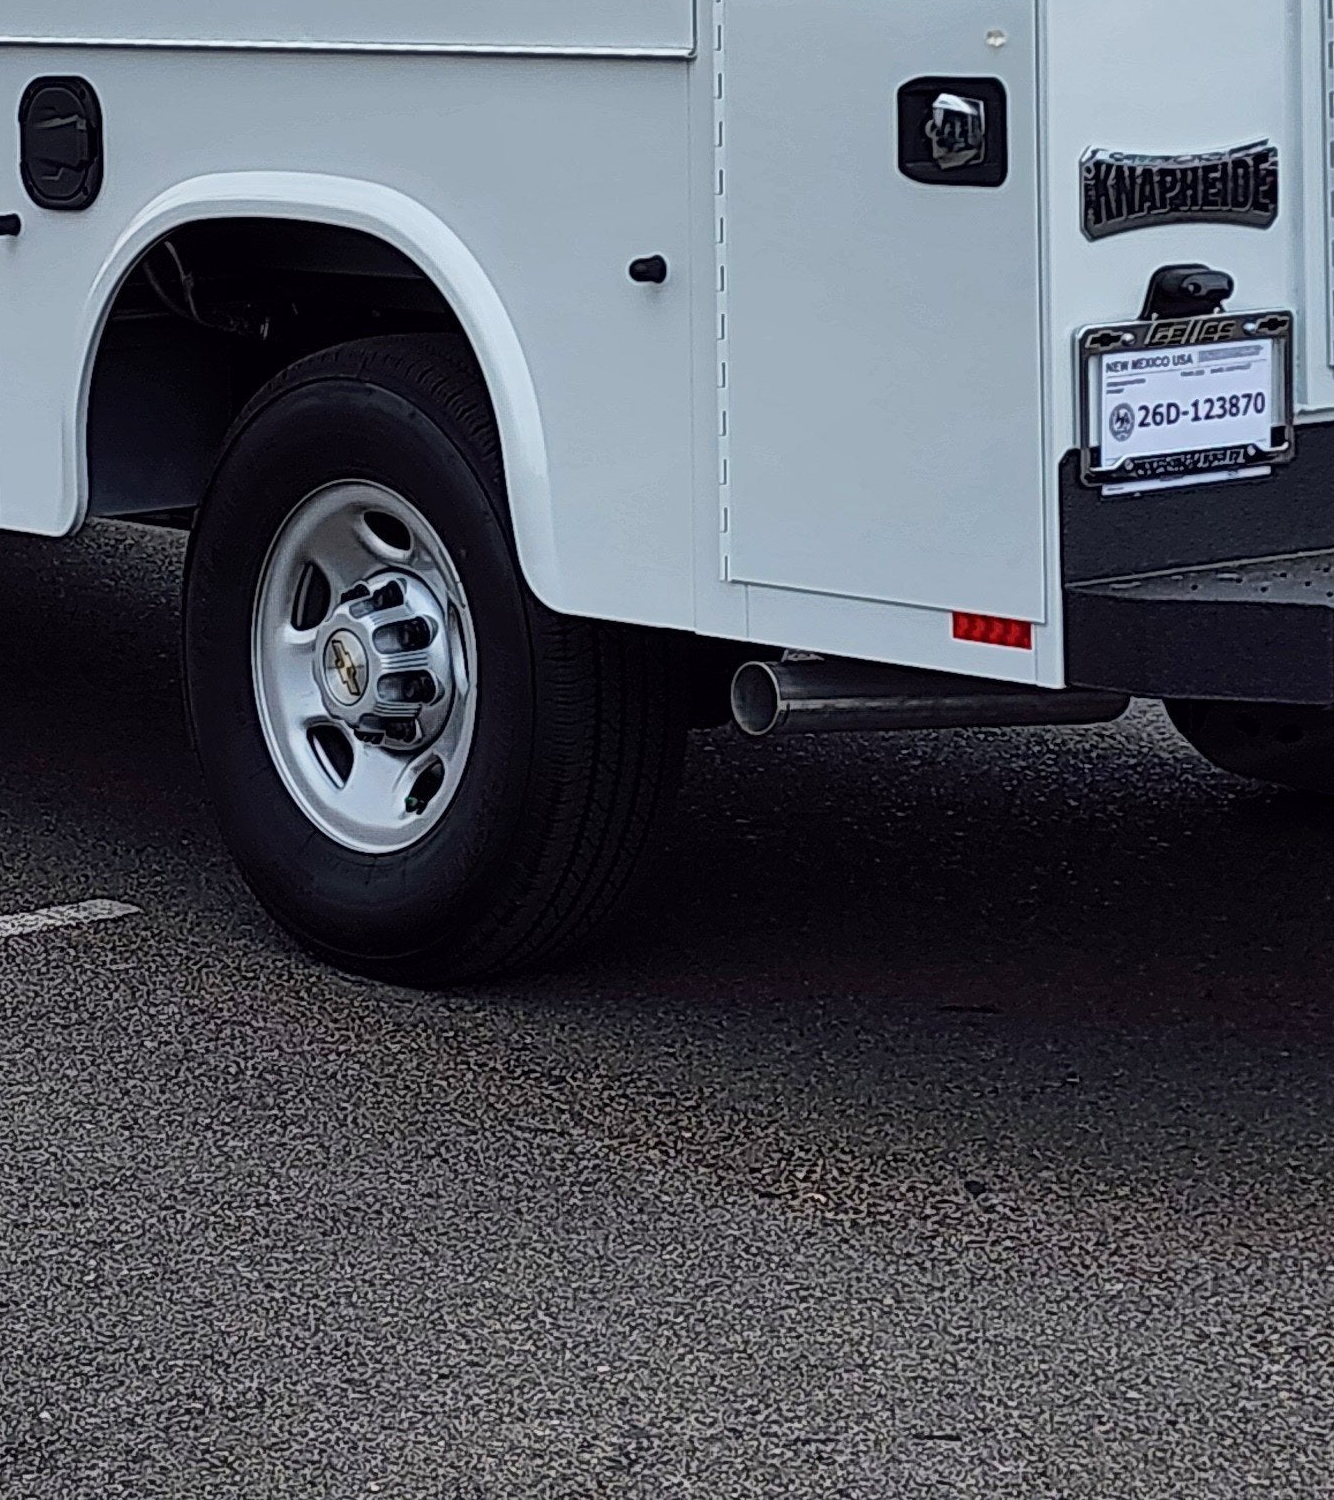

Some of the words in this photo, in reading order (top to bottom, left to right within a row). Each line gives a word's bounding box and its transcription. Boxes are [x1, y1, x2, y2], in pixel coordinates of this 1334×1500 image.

[1092, 152, 1274, 229] KNAPHEIDE
[1105, 360, 1130, 373] NEW
[1131, 355, 1170, 370] MEXICO
[1172, 353, 1193, 367] USA
[1138, 391, 1266, 428] 26D-123870
